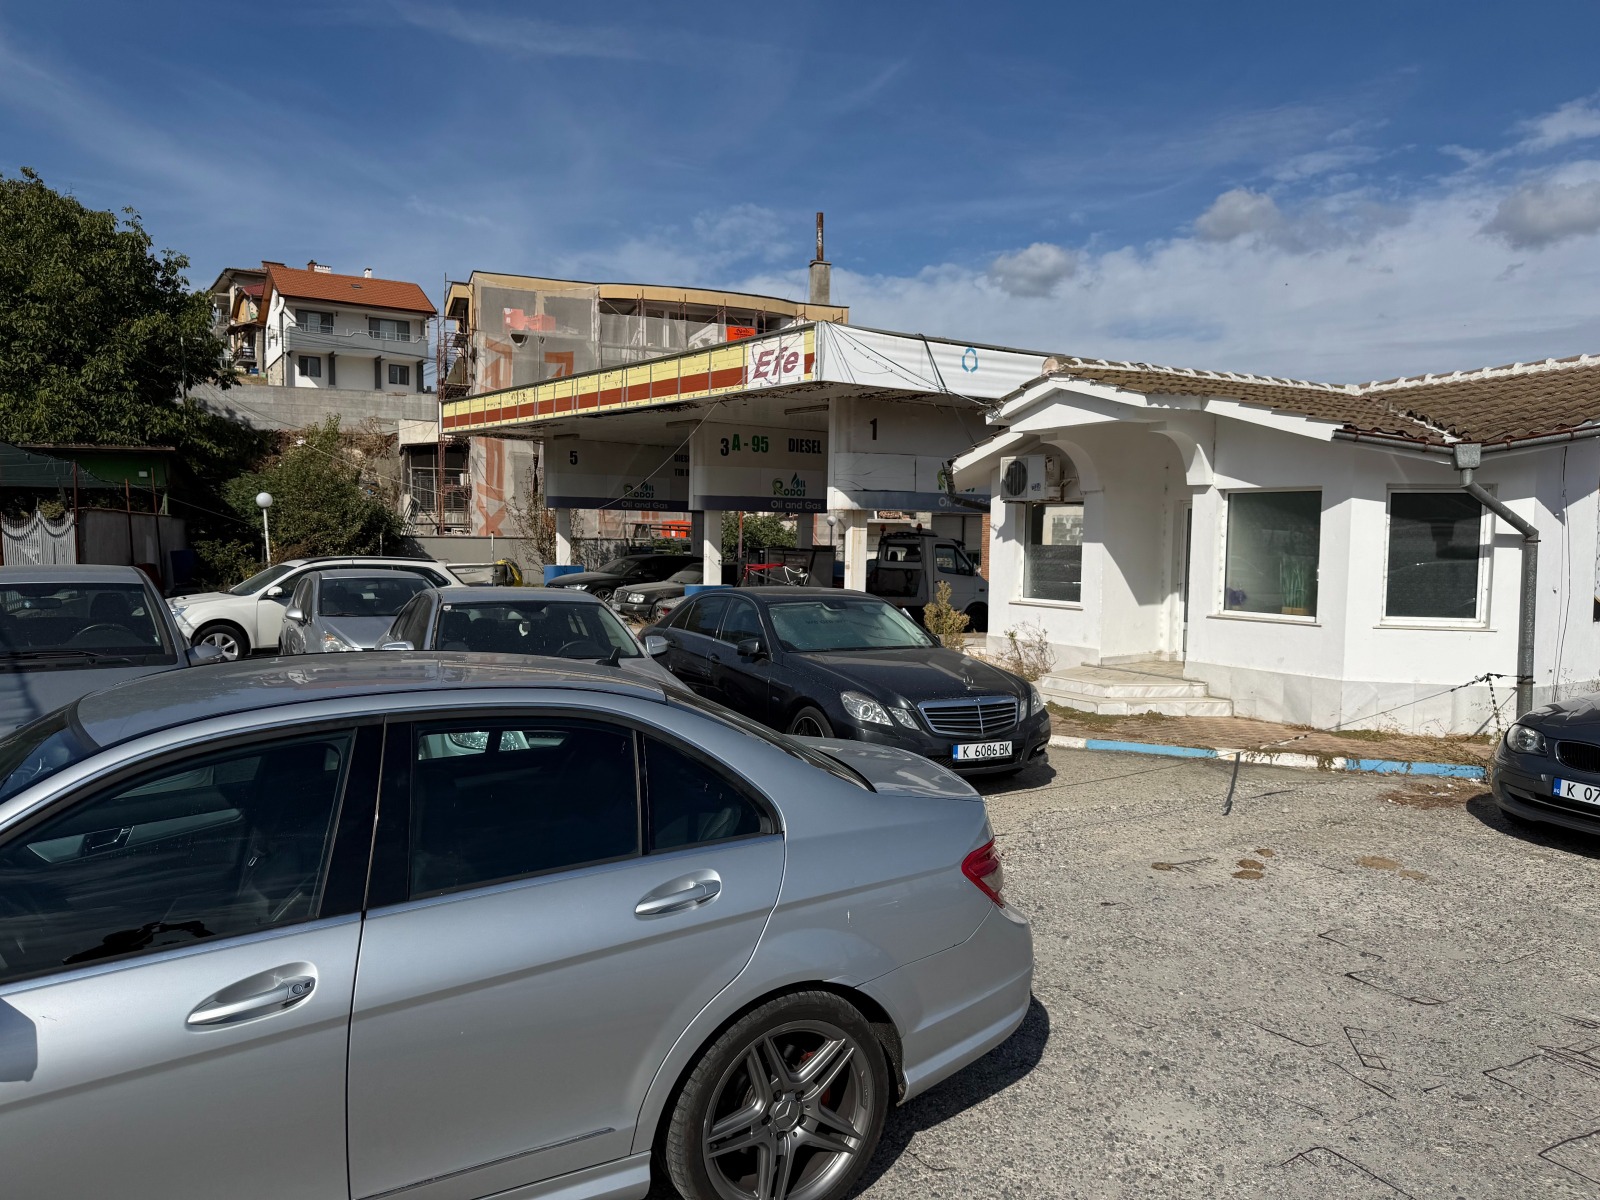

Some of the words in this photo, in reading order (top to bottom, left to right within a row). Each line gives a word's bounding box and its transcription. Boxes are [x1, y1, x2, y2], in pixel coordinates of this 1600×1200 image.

[753, 346, 799, 379] Efe
[869, 418, 878, 440] 1
[720, 438, 729, 456] 3
[788, 438, 822, 454] DIESEL
[569, 450, 578, 465] 5
[674, 454, 690, 463] DIES
[621, 500, 633, 508] Oil
[634, 501, 651, 509] and
[652, 501, 669, 509] Gas
[770, 500, 783, 509] Oil
[785, 501, 803, 510] and
[804, 501, 822, 510] Gas
